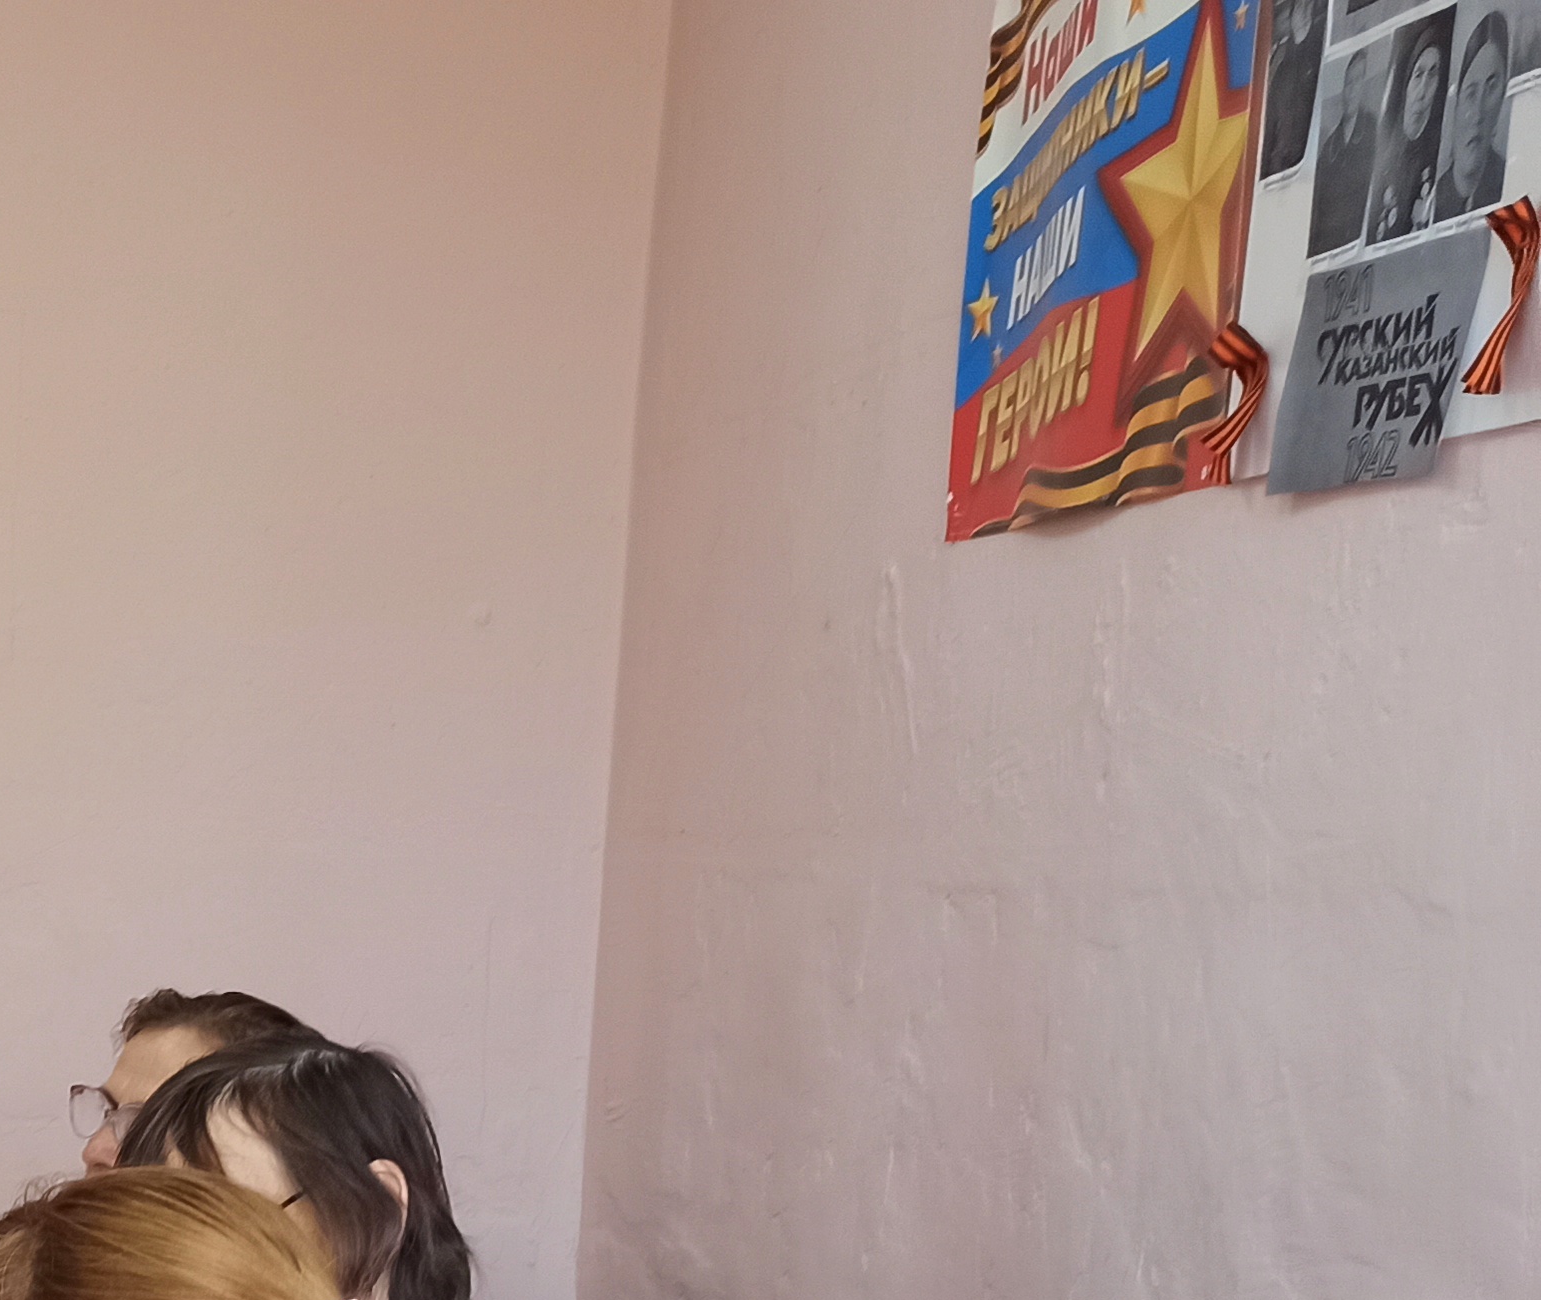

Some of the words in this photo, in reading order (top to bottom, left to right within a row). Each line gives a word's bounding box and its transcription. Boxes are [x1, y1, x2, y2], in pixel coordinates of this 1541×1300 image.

[1007, 184, 1086, 331] НАШИ
[1323, 264, 1375, 324] 1941
[1317, 291, 1441, 387] СУРСКИЙ
[1333, 325, 1461, 387] КАЗАНСКИЙ
[970, 295, 1101, 486] ГЕРОИ!
[1352, 356, 1458, 449] РУБЕЖ
[1343, 429, 1402, 485] 1942
